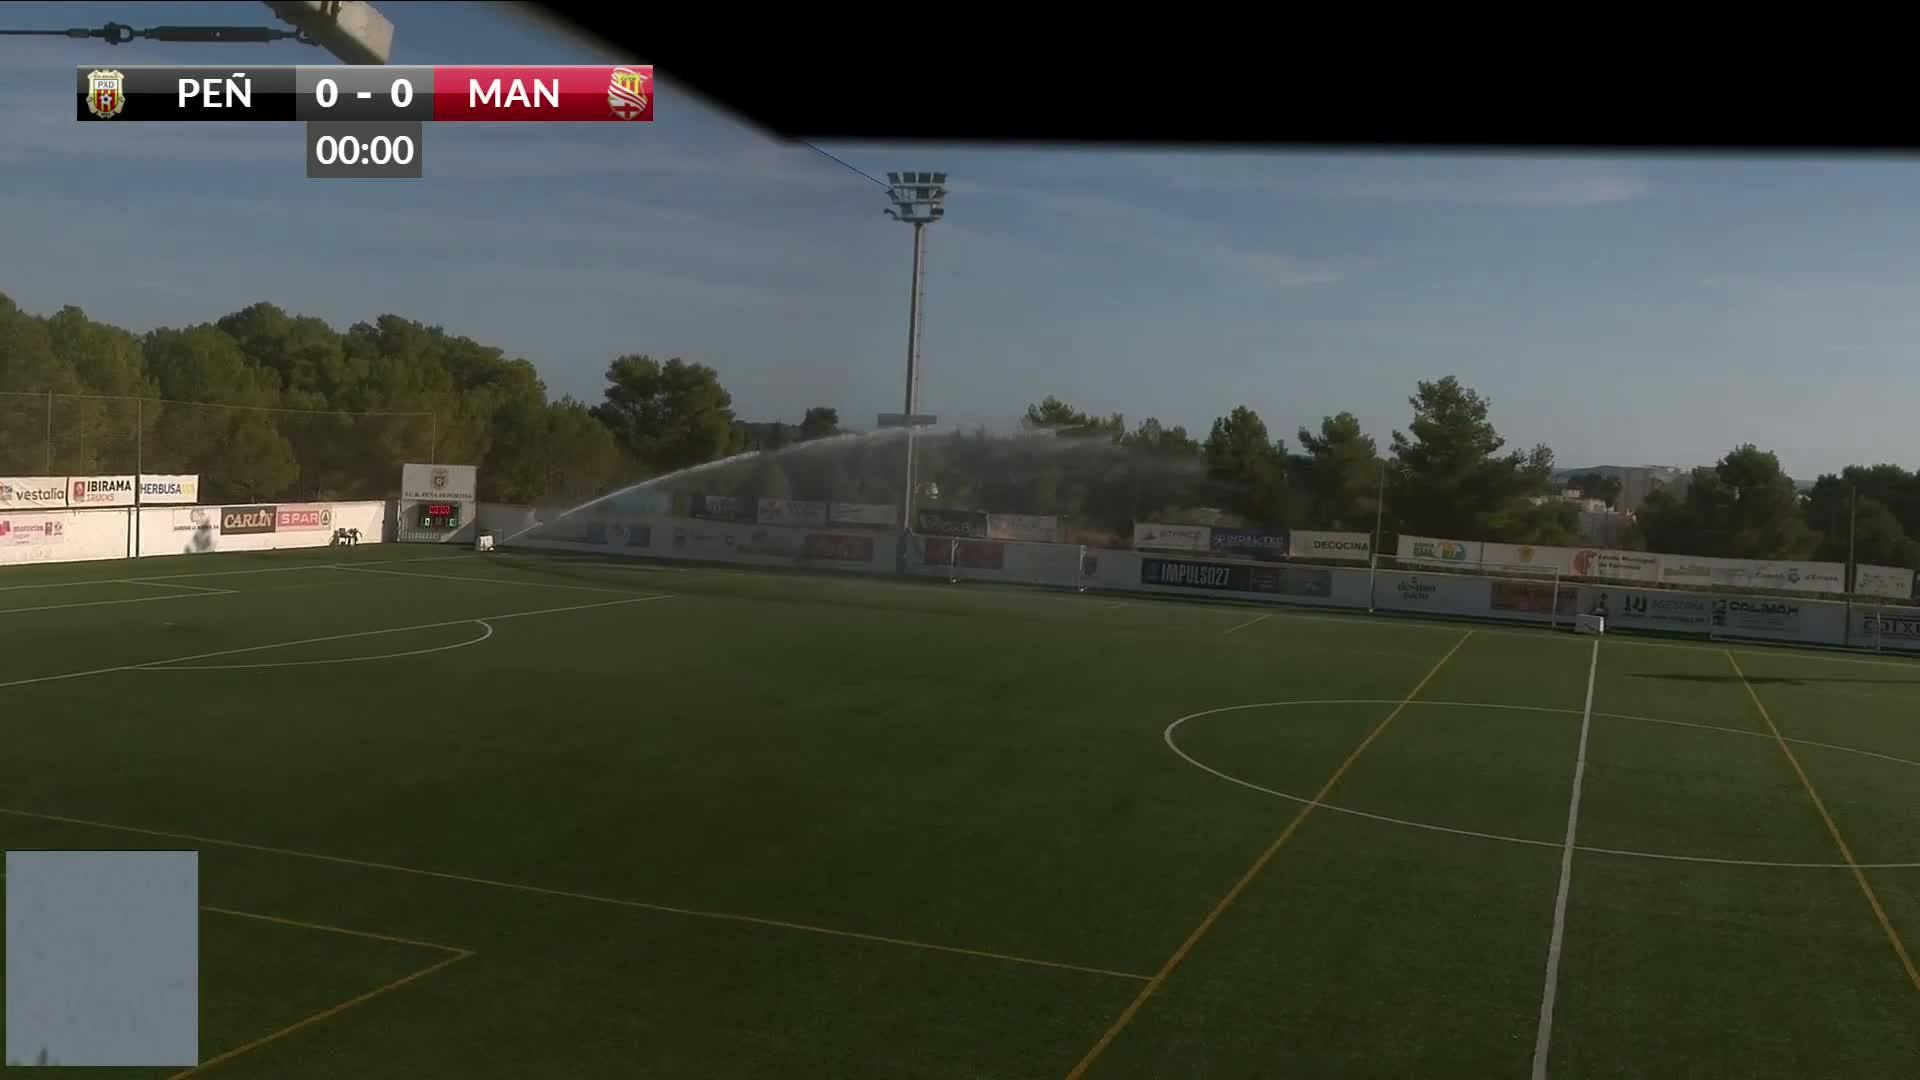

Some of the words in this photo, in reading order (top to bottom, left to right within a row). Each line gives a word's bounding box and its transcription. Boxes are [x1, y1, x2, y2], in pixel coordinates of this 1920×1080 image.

[87, 480, 132, 493] IBIRAMA
[140, 483, 182, 495] HERBUSA
[16, 488, 65, 501] vestalia
[281, 512, 319, 525] SPAR
[1312, 540, 1369, 551] DECOCINA
[1161, 562, 1231, 586] IMPULSO27
